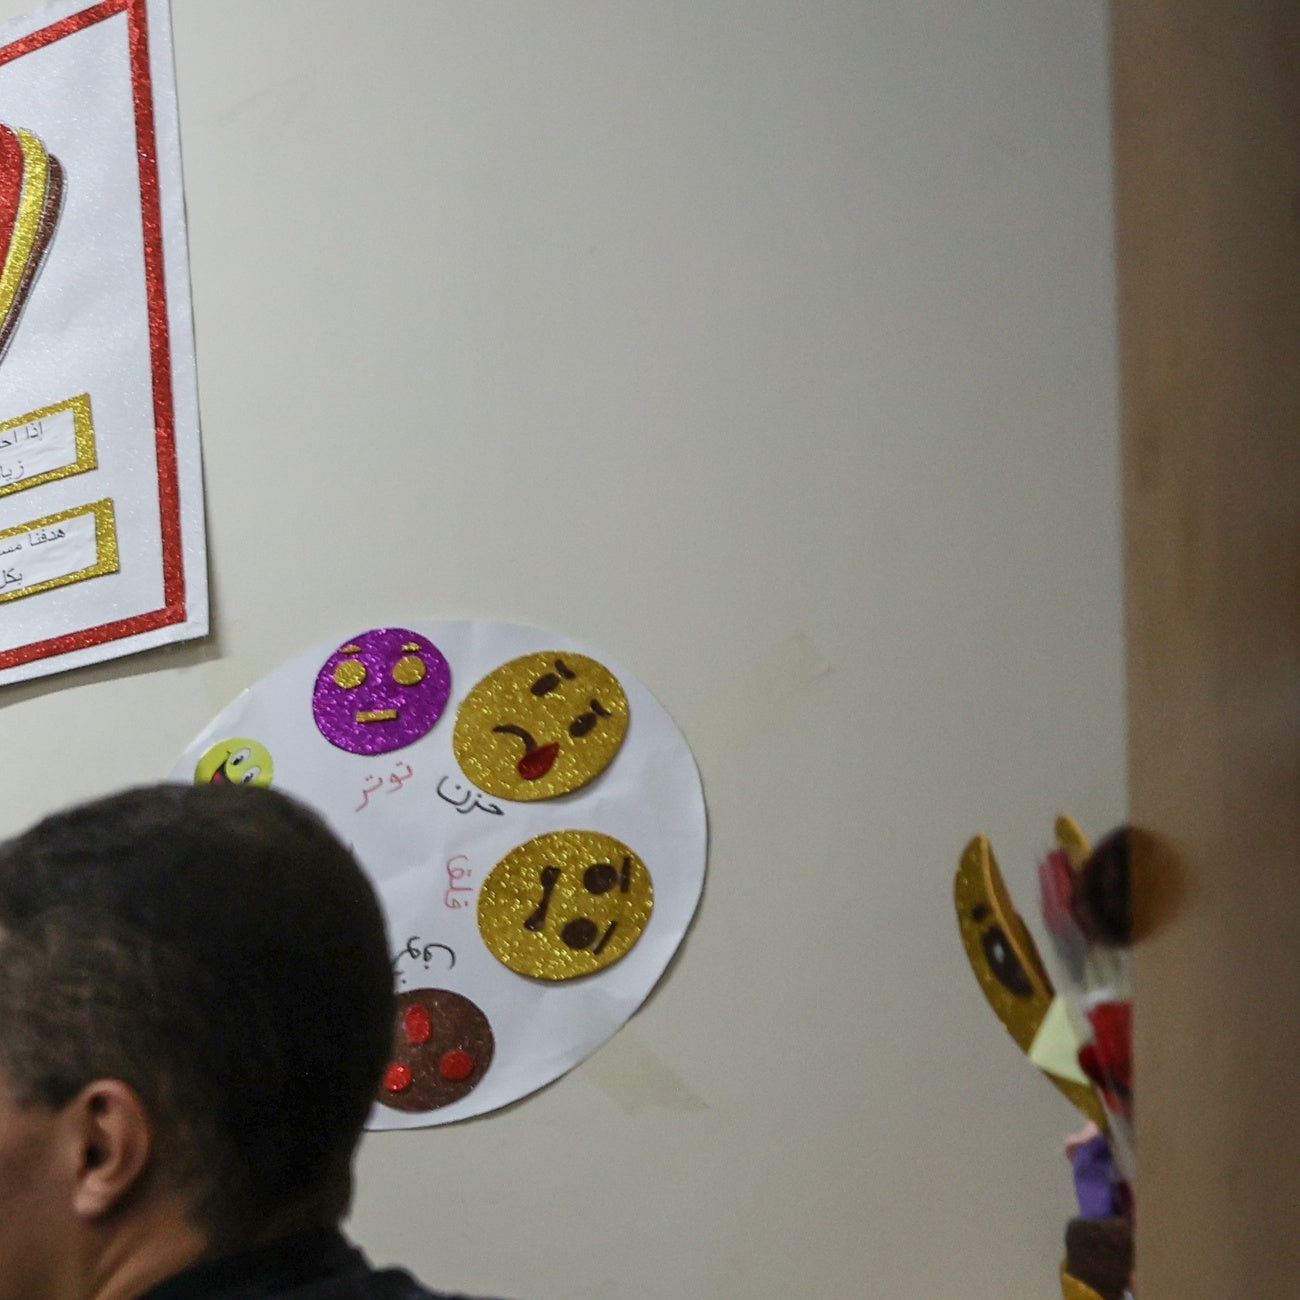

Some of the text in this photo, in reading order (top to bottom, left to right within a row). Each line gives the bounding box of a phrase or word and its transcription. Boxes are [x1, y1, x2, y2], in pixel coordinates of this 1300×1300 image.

[28, 527, 66, 547] هدفنا
[354, 761, 414, 813] توتر
[436, 775, 505, 817] حزن
[444, 854, 474, 910] قلق
